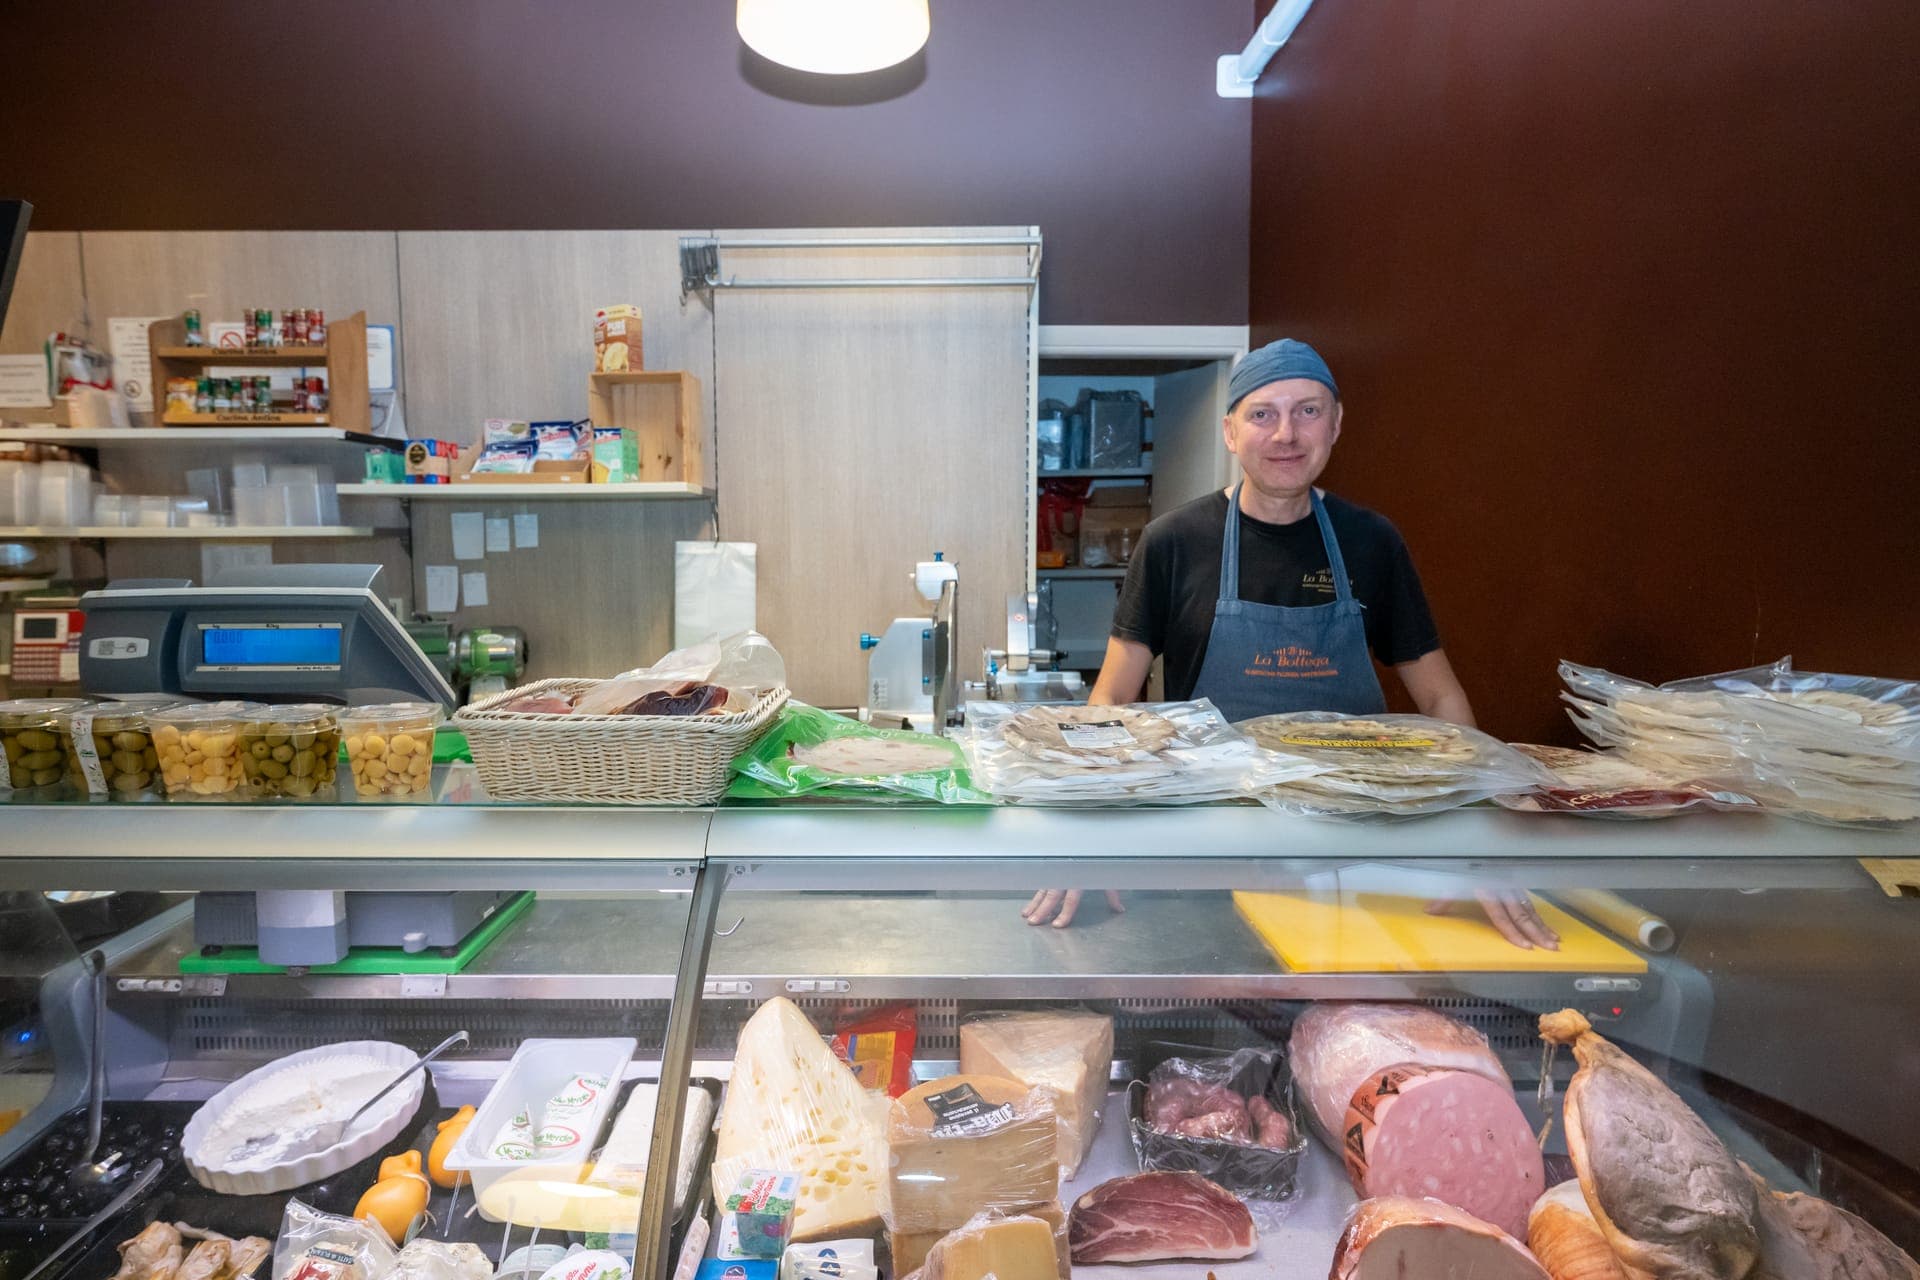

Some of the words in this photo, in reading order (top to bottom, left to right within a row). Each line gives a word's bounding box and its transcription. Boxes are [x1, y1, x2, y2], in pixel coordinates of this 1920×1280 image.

[1303, 574, 1316, 582] La
[1254, 654, 1272, 666] La
[1277, 655, 1330, 668] Bottega
[545, 1132, 574, 1143] Verde
